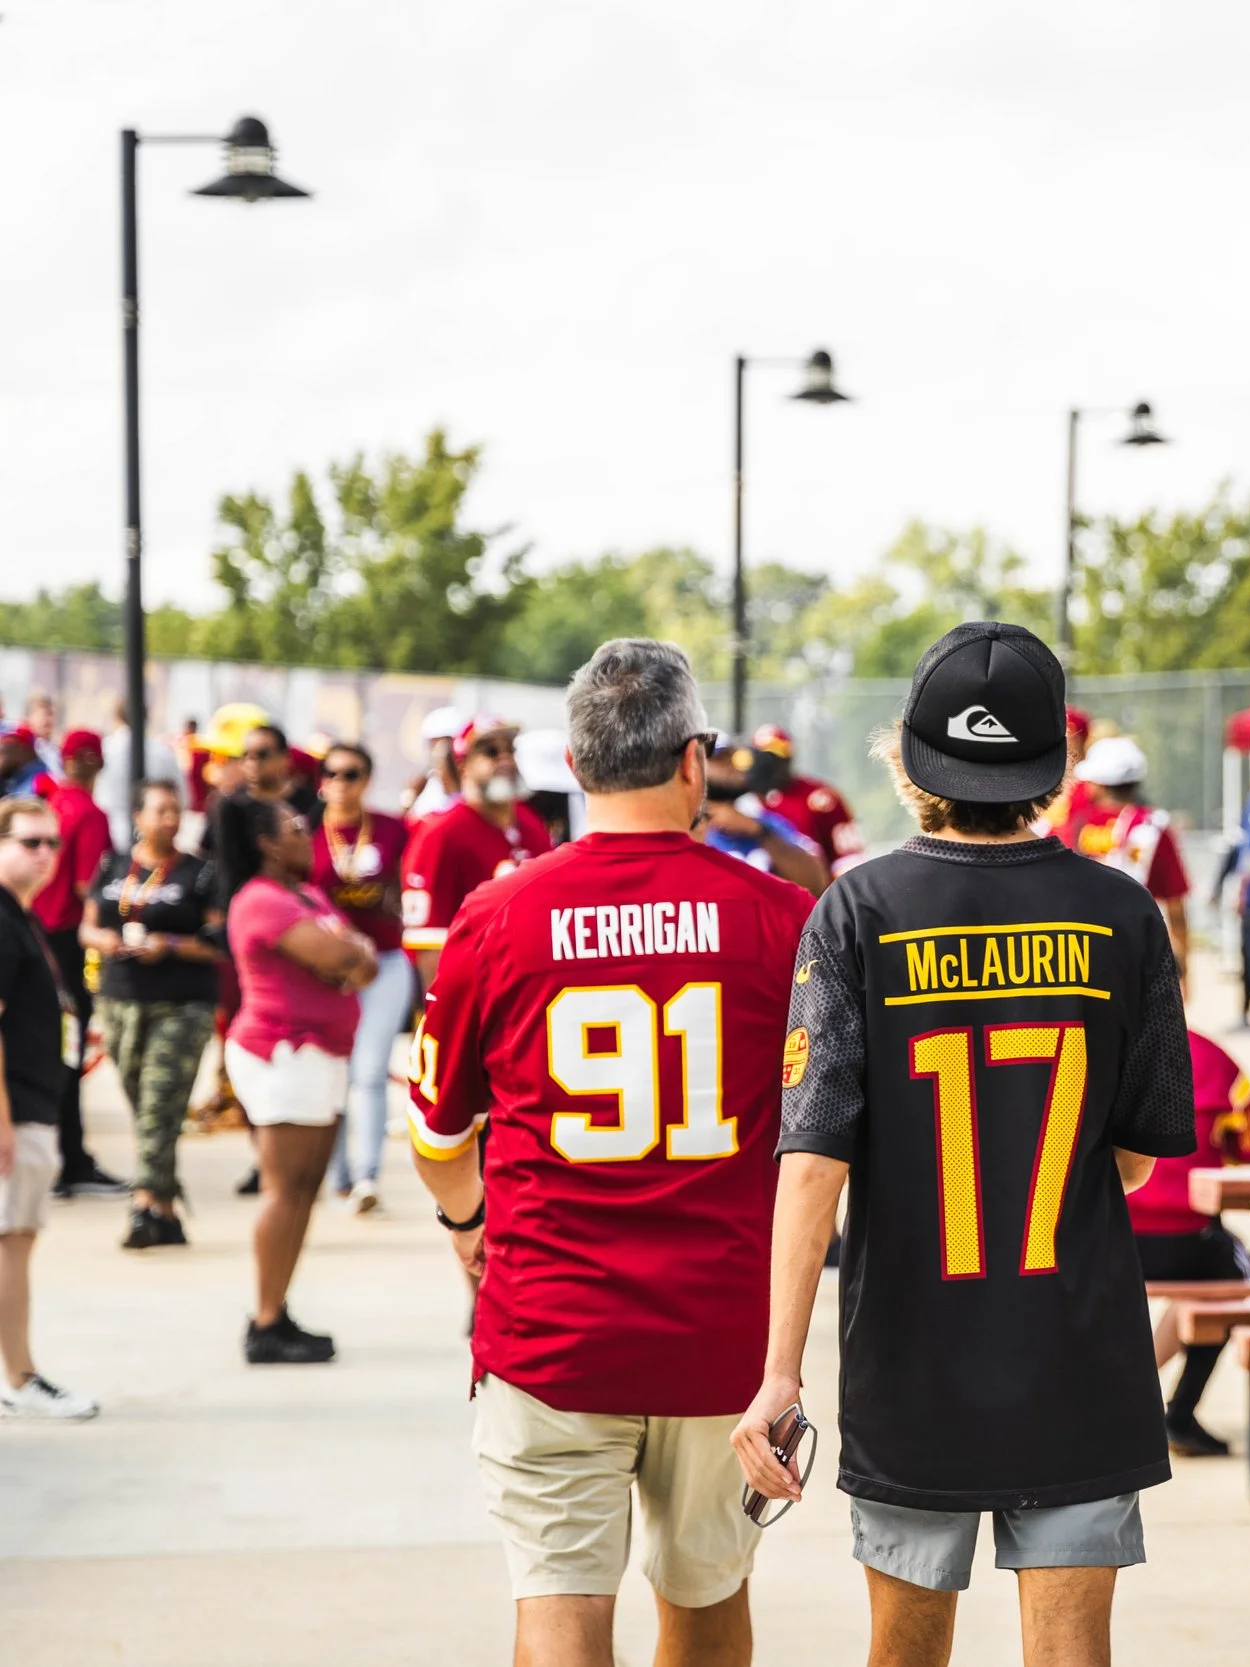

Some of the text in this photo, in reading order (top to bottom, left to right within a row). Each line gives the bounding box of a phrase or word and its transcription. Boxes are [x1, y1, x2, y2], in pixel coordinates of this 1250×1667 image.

[551, 901, 720, 961] KERRIGAN
[906, 933, 1091, 992] McLAURIN
[546, 981, 740, 1164] 91
[908, 1020, 1088, 1282] 17
